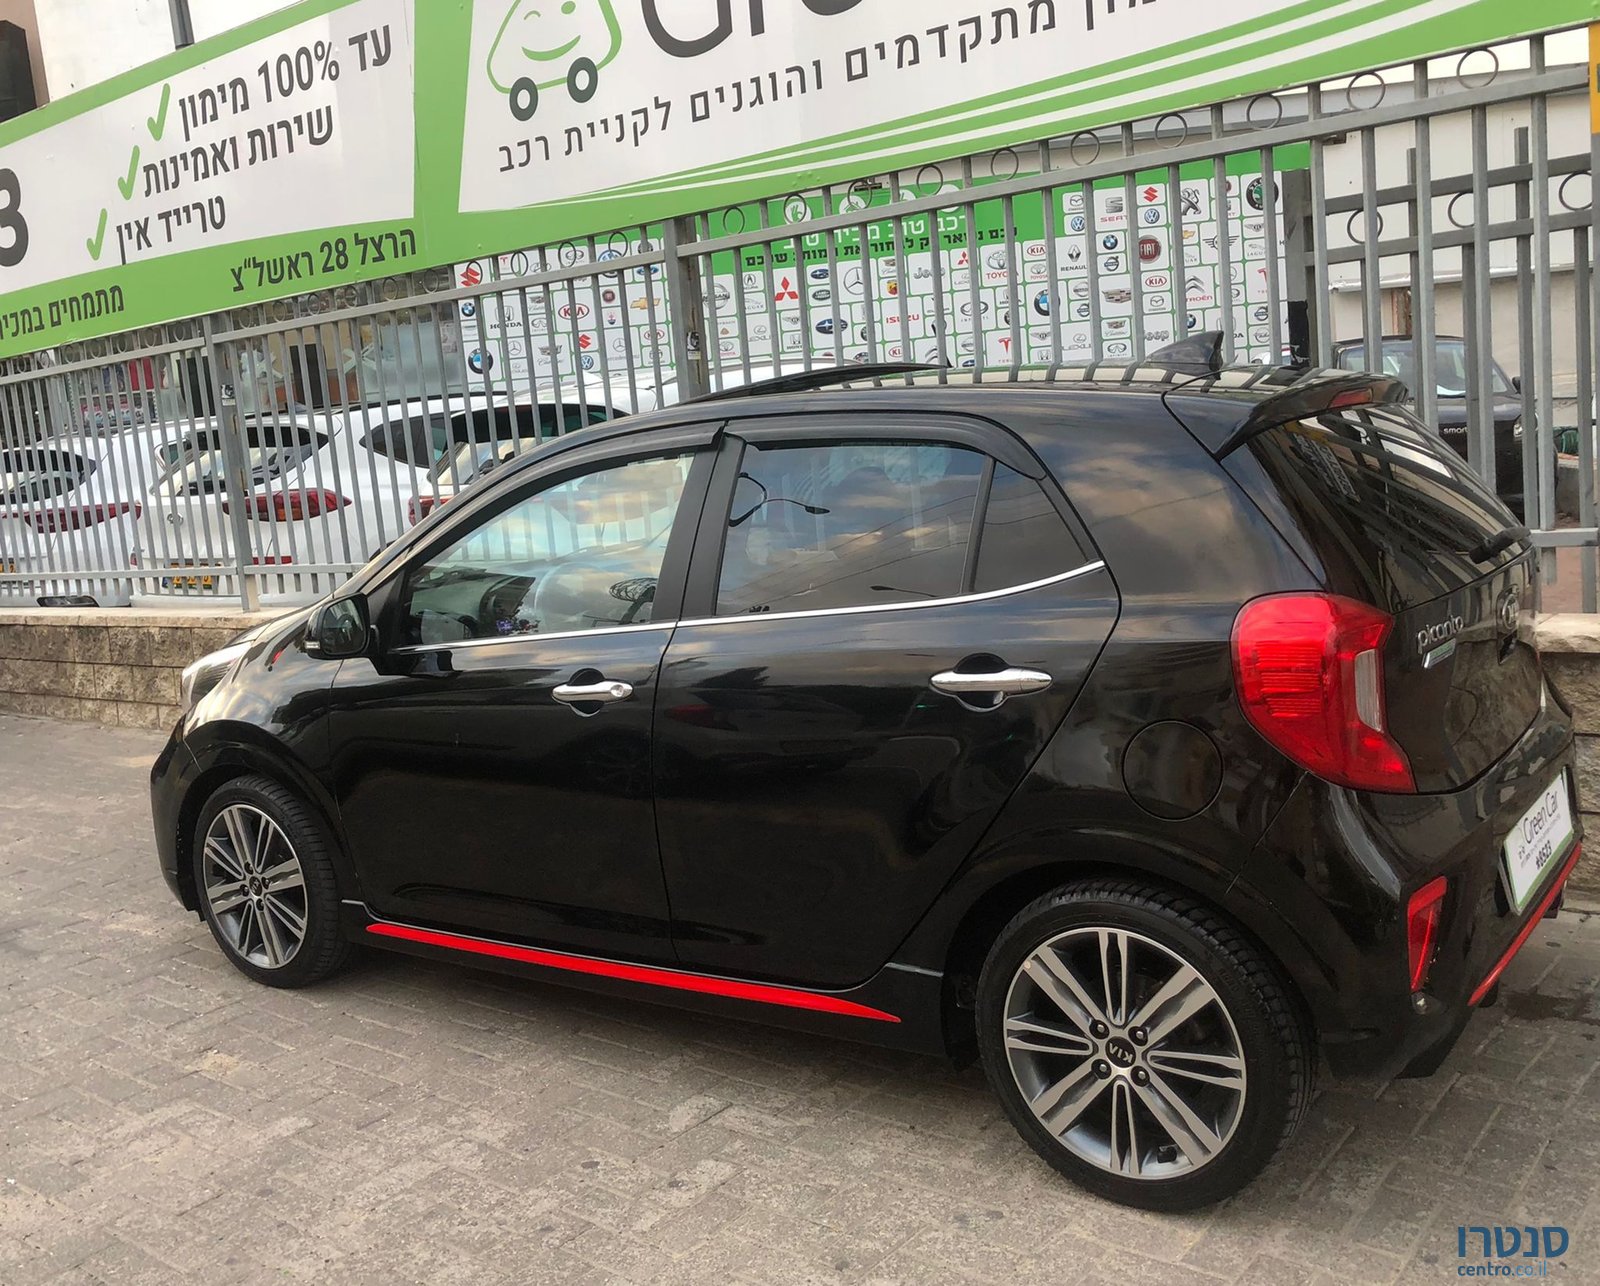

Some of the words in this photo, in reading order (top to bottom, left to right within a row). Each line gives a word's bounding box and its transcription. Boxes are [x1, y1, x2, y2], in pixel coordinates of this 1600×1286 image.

[348, 24, 392, 72] עד
[845, 0, 1056, 82] מתקדמים
[258, 40, 340, 103] 100%
[689, 59, 823, 123] והוגנים
[178, 76, 249, 142] מימון
[563, 96, 672, 156] לקניית
[248, 105, 334, 167] שירות
[498, 134, 551, 173] רכב
[143, 136, 241, 198] ואמינות
[116, 216, 152, 265] אין
[157, 195, 226, 244] טרייד
[320, 237, 350, 273] 28
[354, 228, 417, 266] הרצל
[1139, 242, 1157, 256] FIAT
[1148, 277, 1165, 286] KIA
[48, 284, 125, 328] מתמחים
[1417, 614, 1465, 655] picanto
[1522, 805, 1548, 845] Green
[1108, 1042, 1134, 1064] KIA
